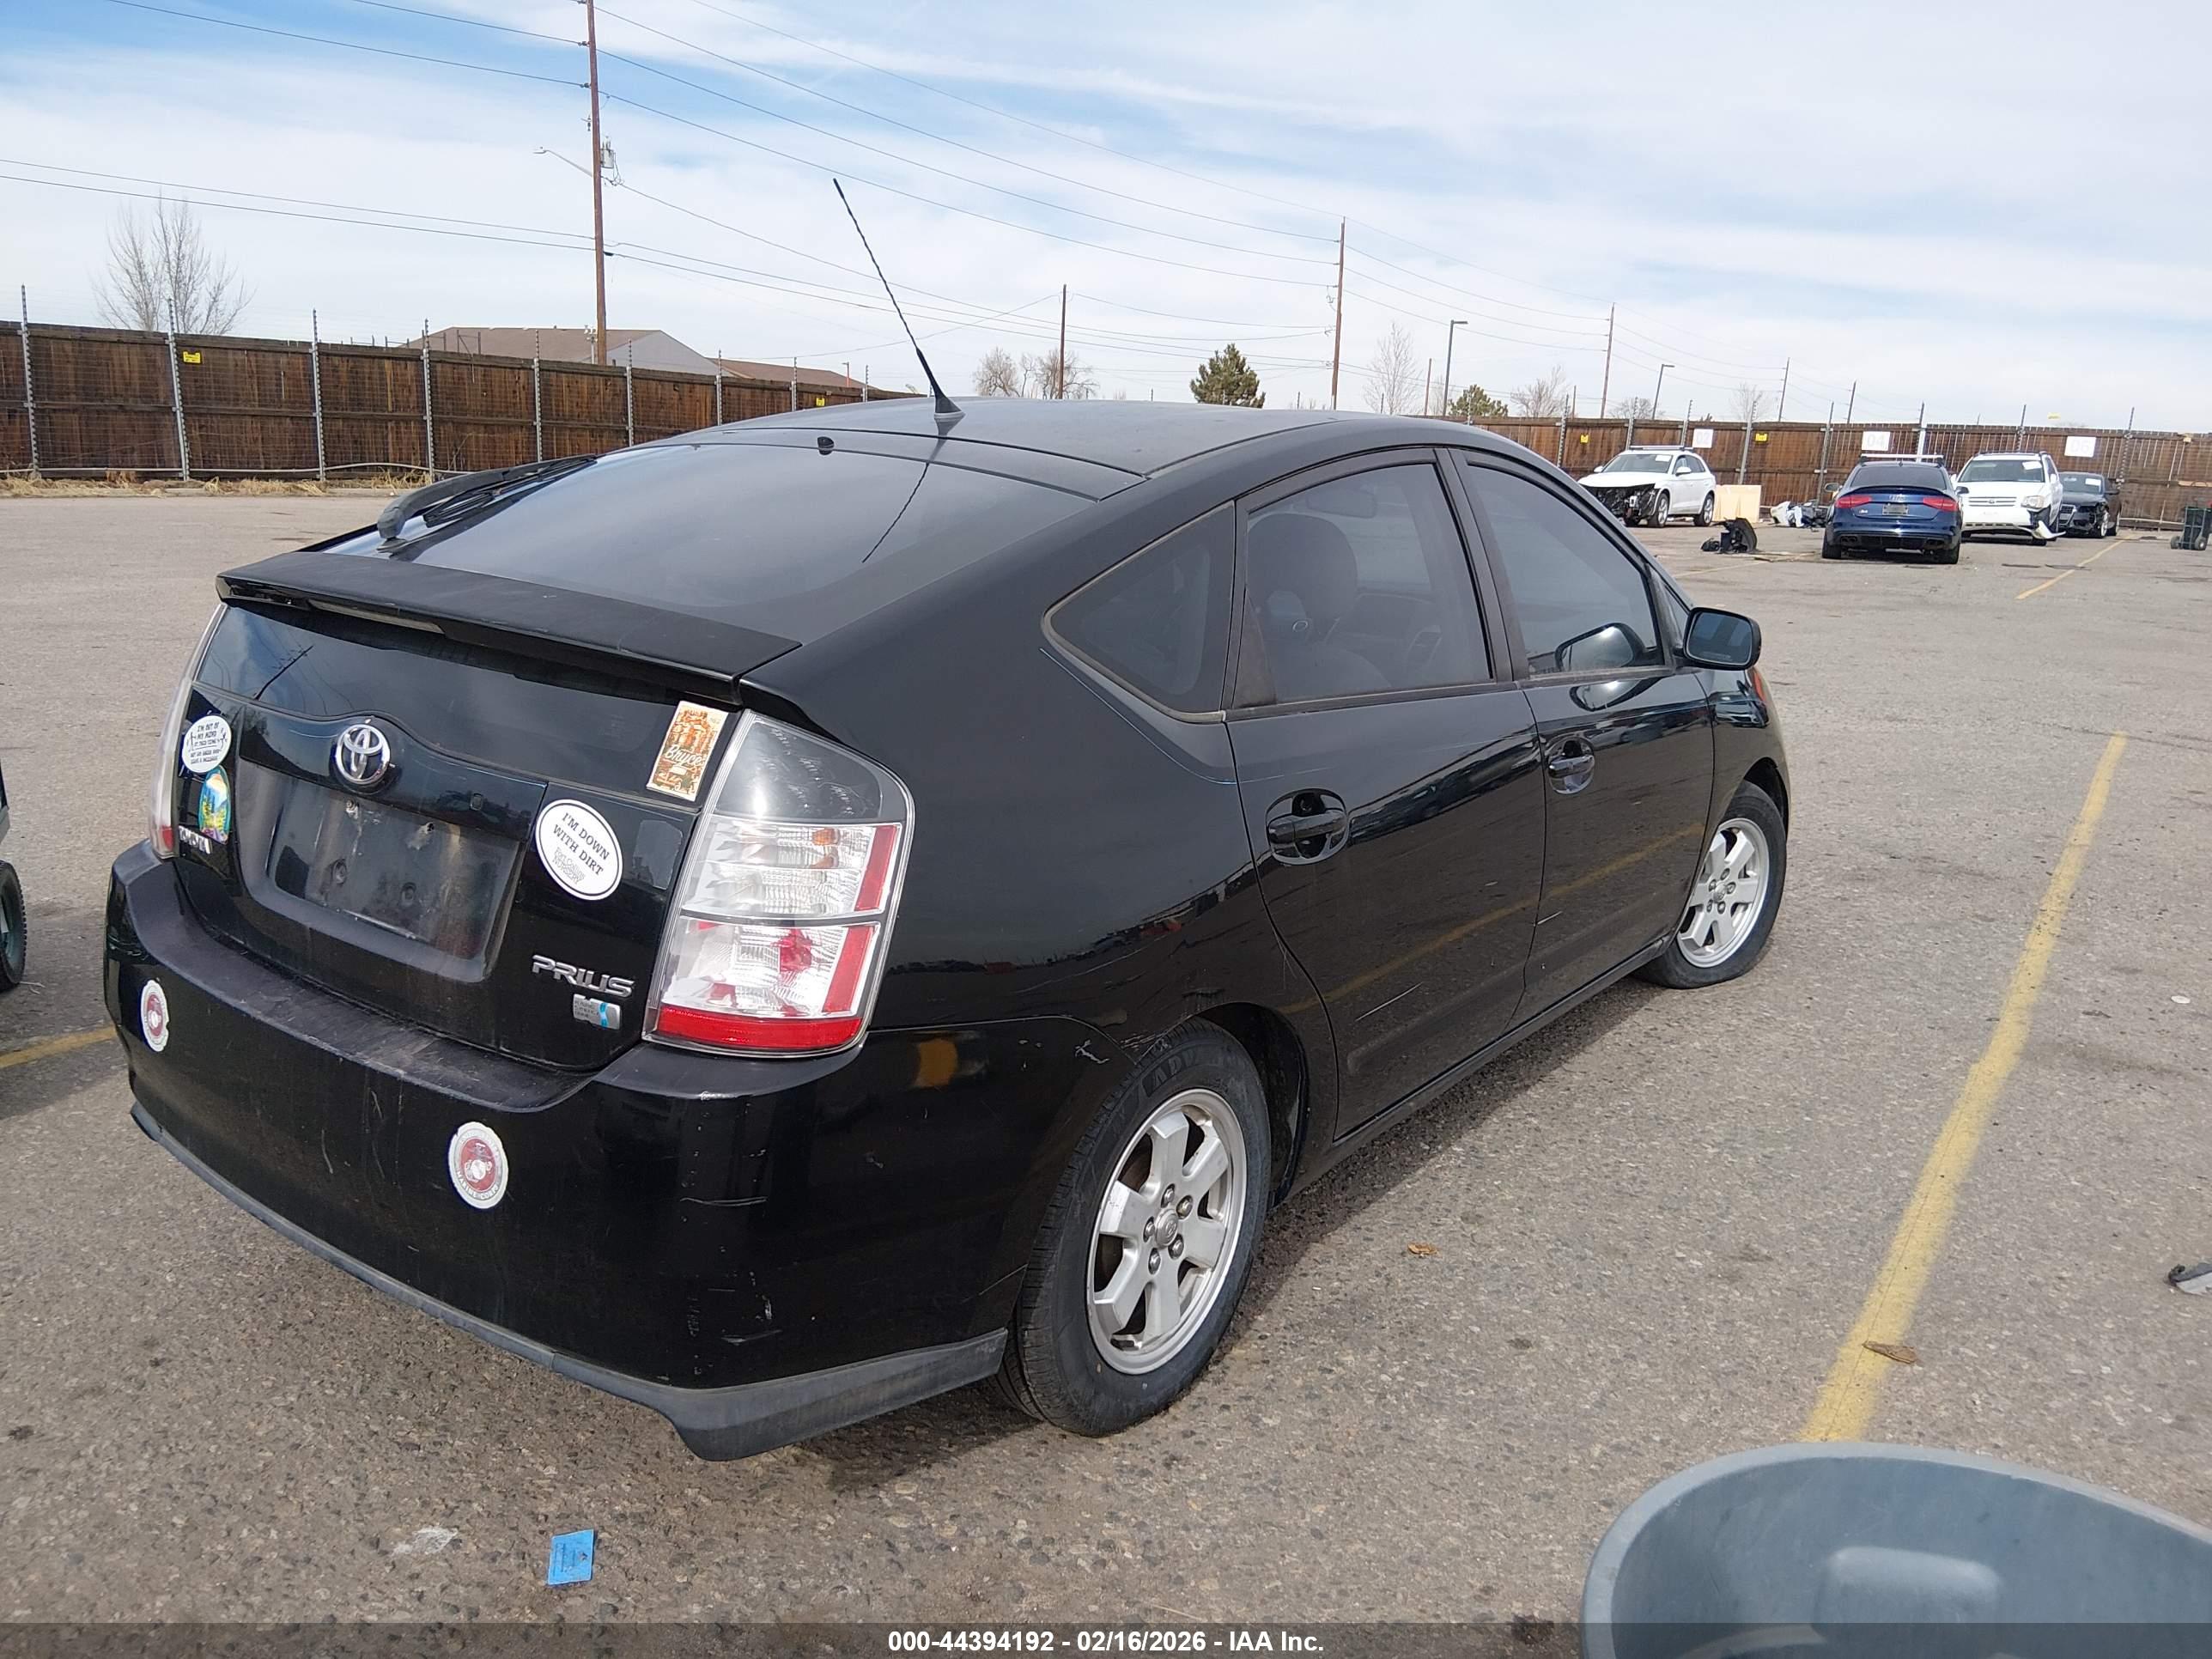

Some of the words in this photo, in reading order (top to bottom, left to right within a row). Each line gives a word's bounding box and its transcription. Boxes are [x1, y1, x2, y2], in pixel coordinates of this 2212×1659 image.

[665, 744, 703, 766] Bryce
[553, 824, 579, 853] WITH
[579, 849, 604, 876] DIRT
[562, 812, 580, 831] I'M
[579, 828, 610, 860] DOWN
[532, 954, 635, 998] PRIUS
